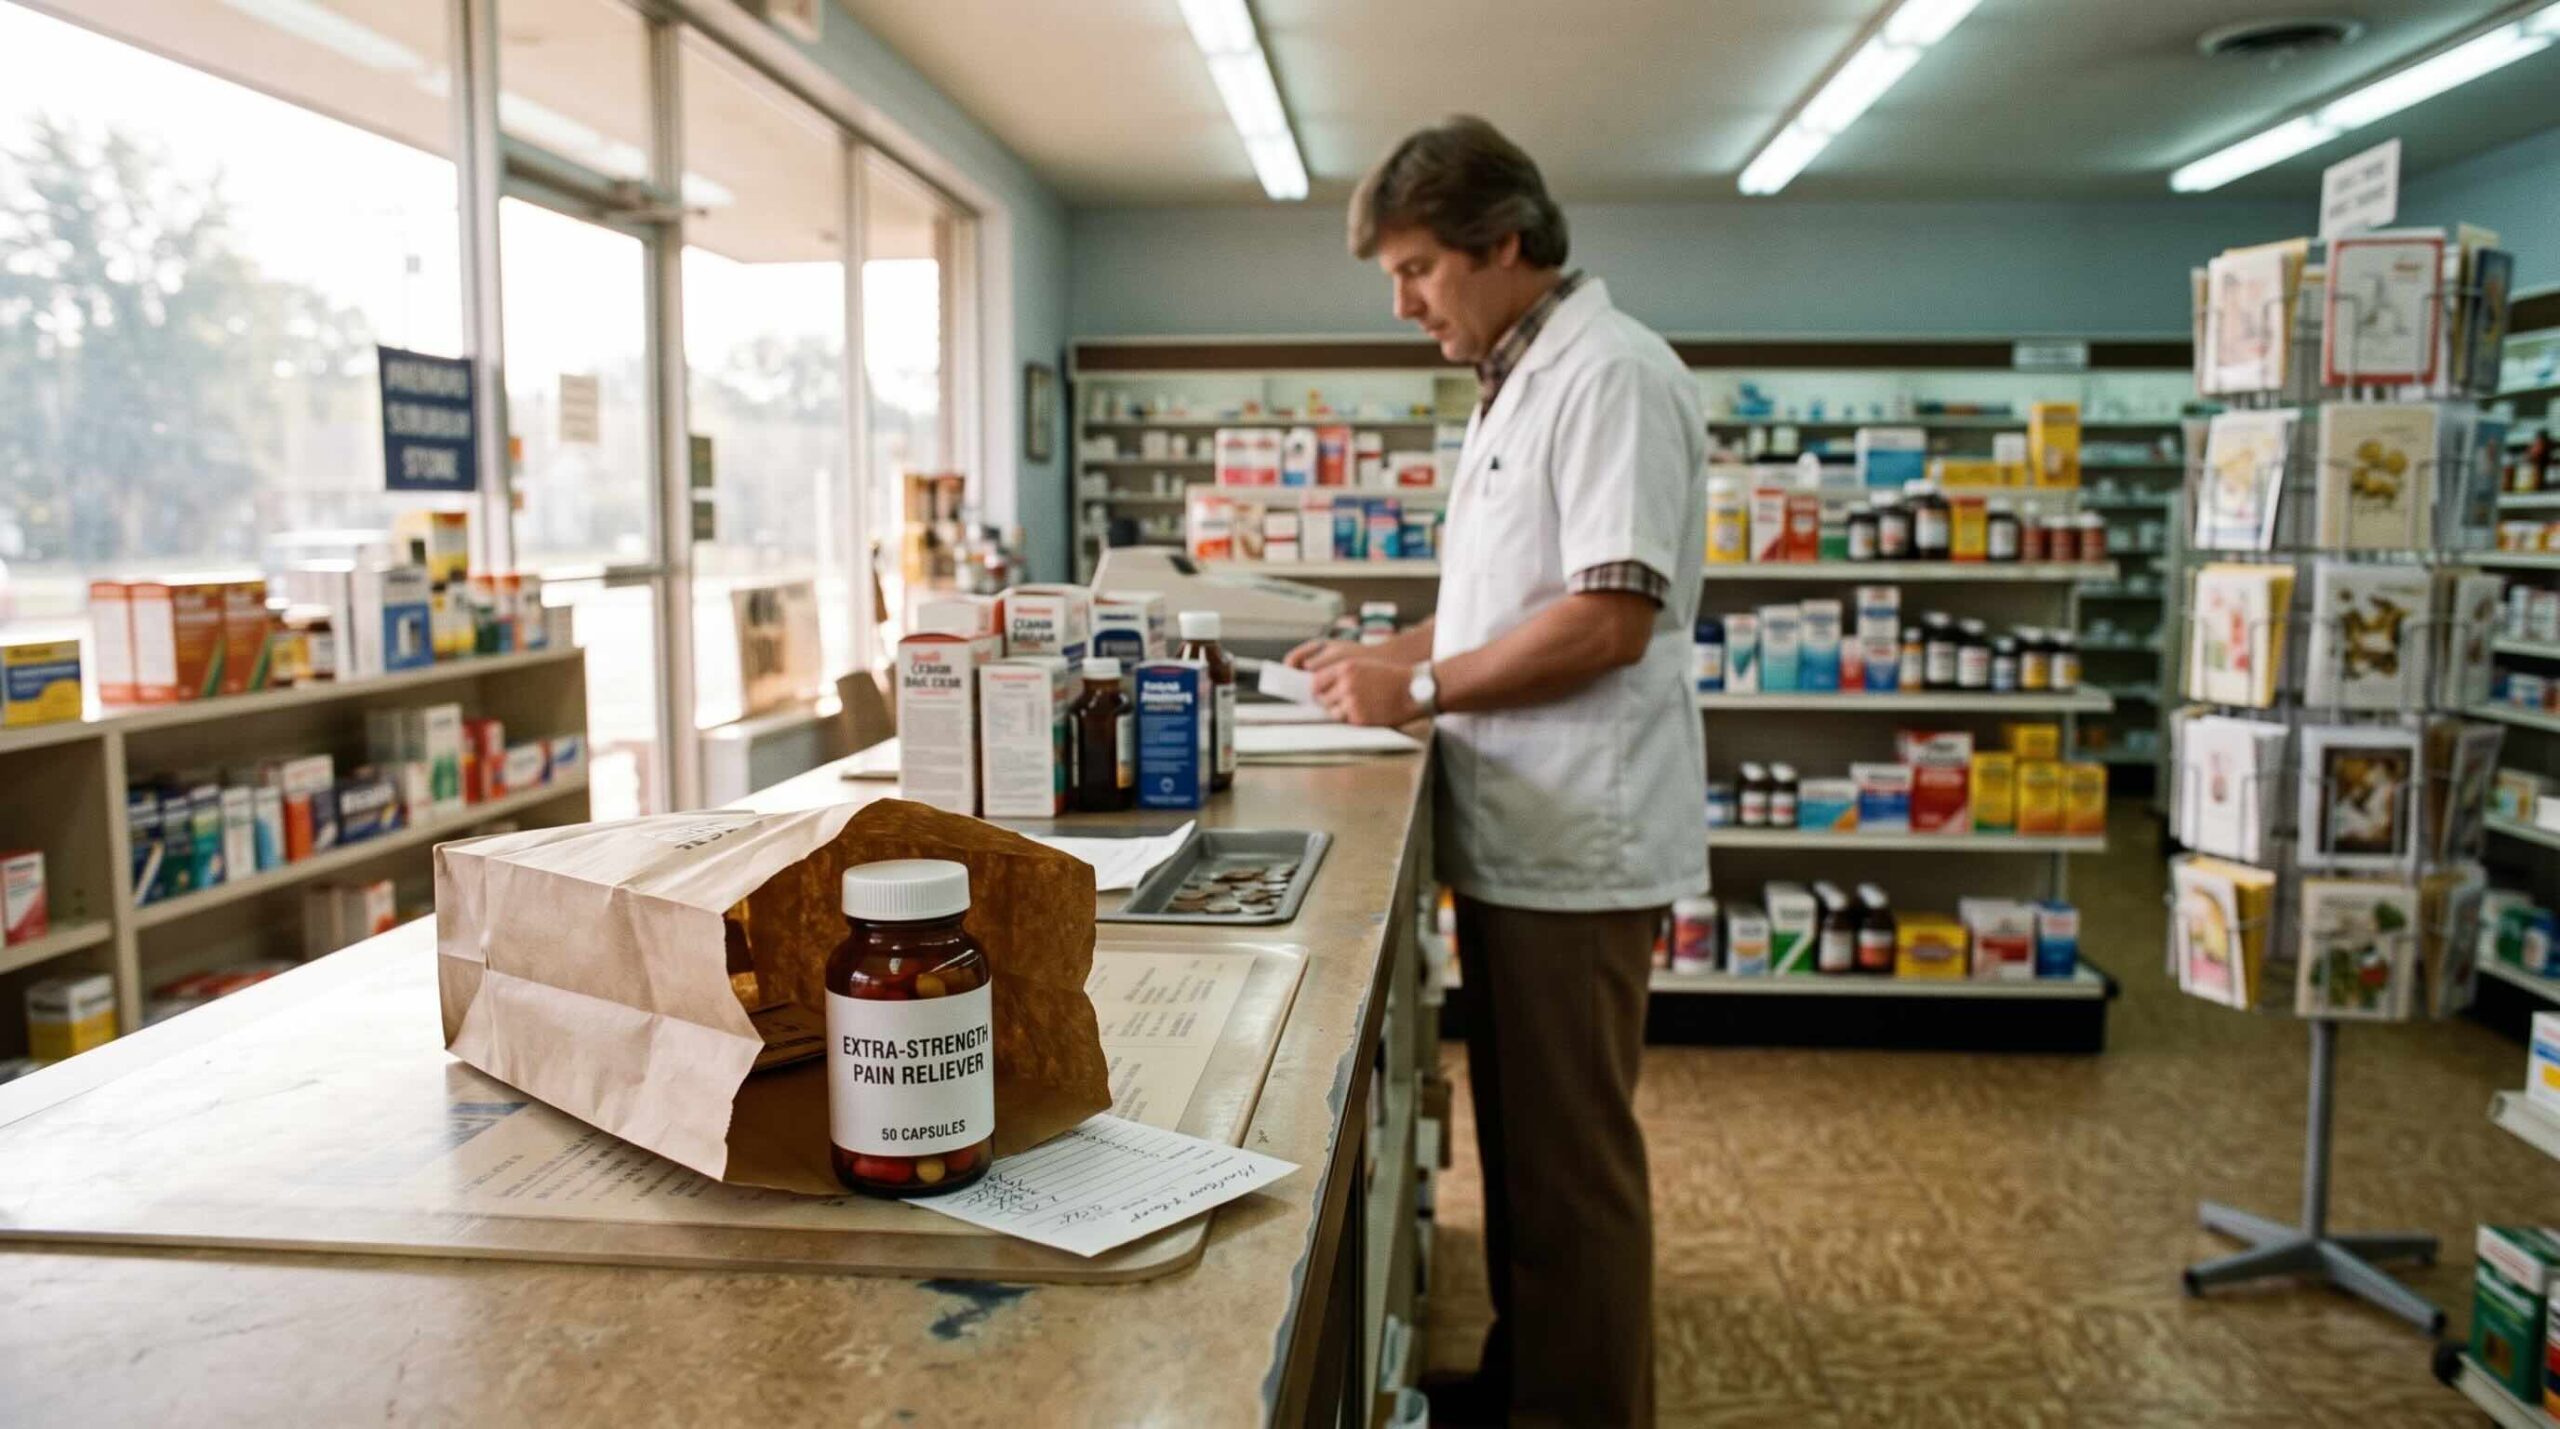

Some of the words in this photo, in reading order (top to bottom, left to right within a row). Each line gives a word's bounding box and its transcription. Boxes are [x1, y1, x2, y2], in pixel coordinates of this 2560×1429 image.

[843, 1023, 989, 1059] EXTRA-STRENGTH
[854, 1064, 895, 1085] PAIN
[902, 1052, 984, 1085] RELIEVER
[882, 1128, 897, 1141] 50
[902, 1119, 966, 1141] CAPSULES
